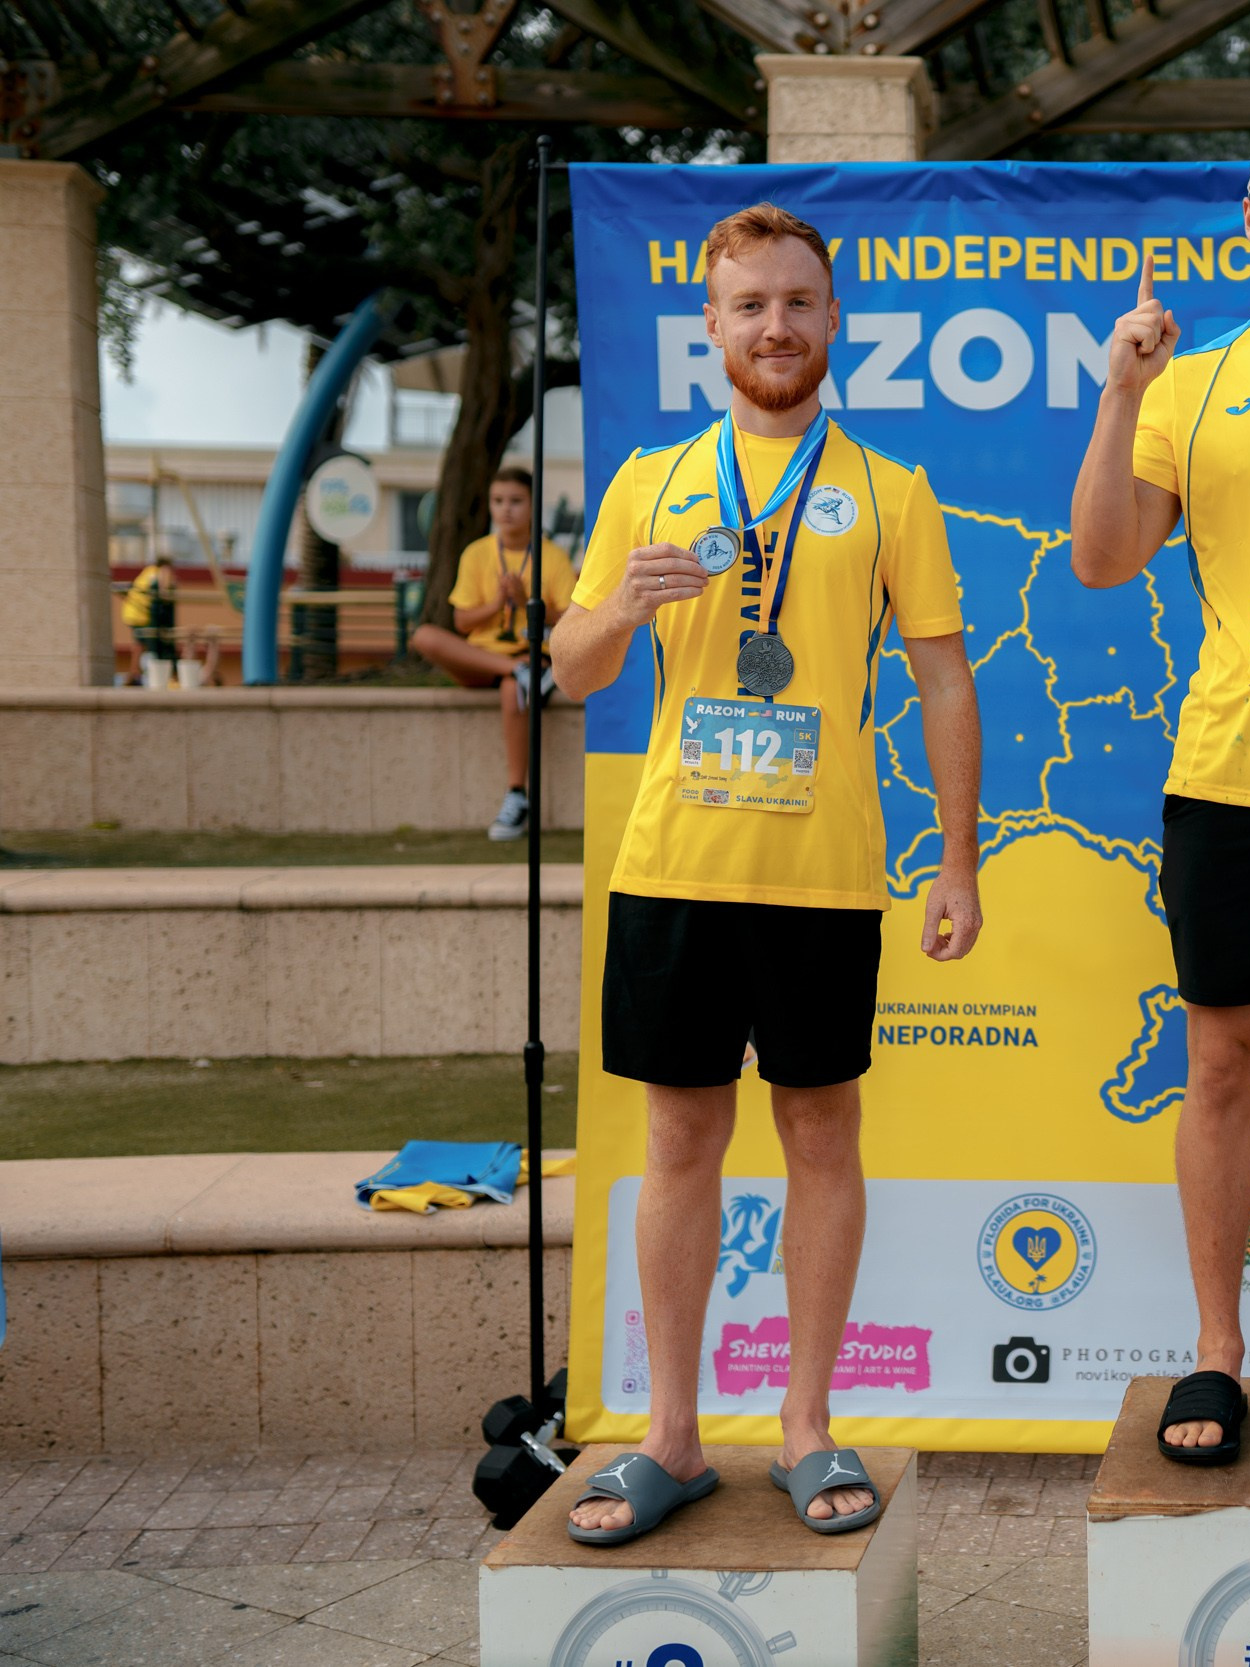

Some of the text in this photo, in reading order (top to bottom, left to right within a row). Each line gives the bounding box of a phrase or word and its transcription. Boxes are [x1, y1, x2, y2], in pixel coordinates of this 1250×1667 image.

[656, 308, 1115, 412] RZOM
[696, 704, 806, 723] RAZOM RUN
[798, 732, 812, 741] 5K
[714, 727, 782, 775] 112
[735, 795, 808, 807] SLAVA UKRAINI!
[877, 1003, 1037, 1017] UKRAINIAN OLYMPIAN
[878, 1025, 1038, 1047] NEPORADNA
[983, 1197, 1091, 1247] FLORIDA FOR UKRAINE
[727, 1363, 771, 1372] PAINTING
[864, 1365, 881, 1374] ART
[893, 1366, 917, 1375] WINE
